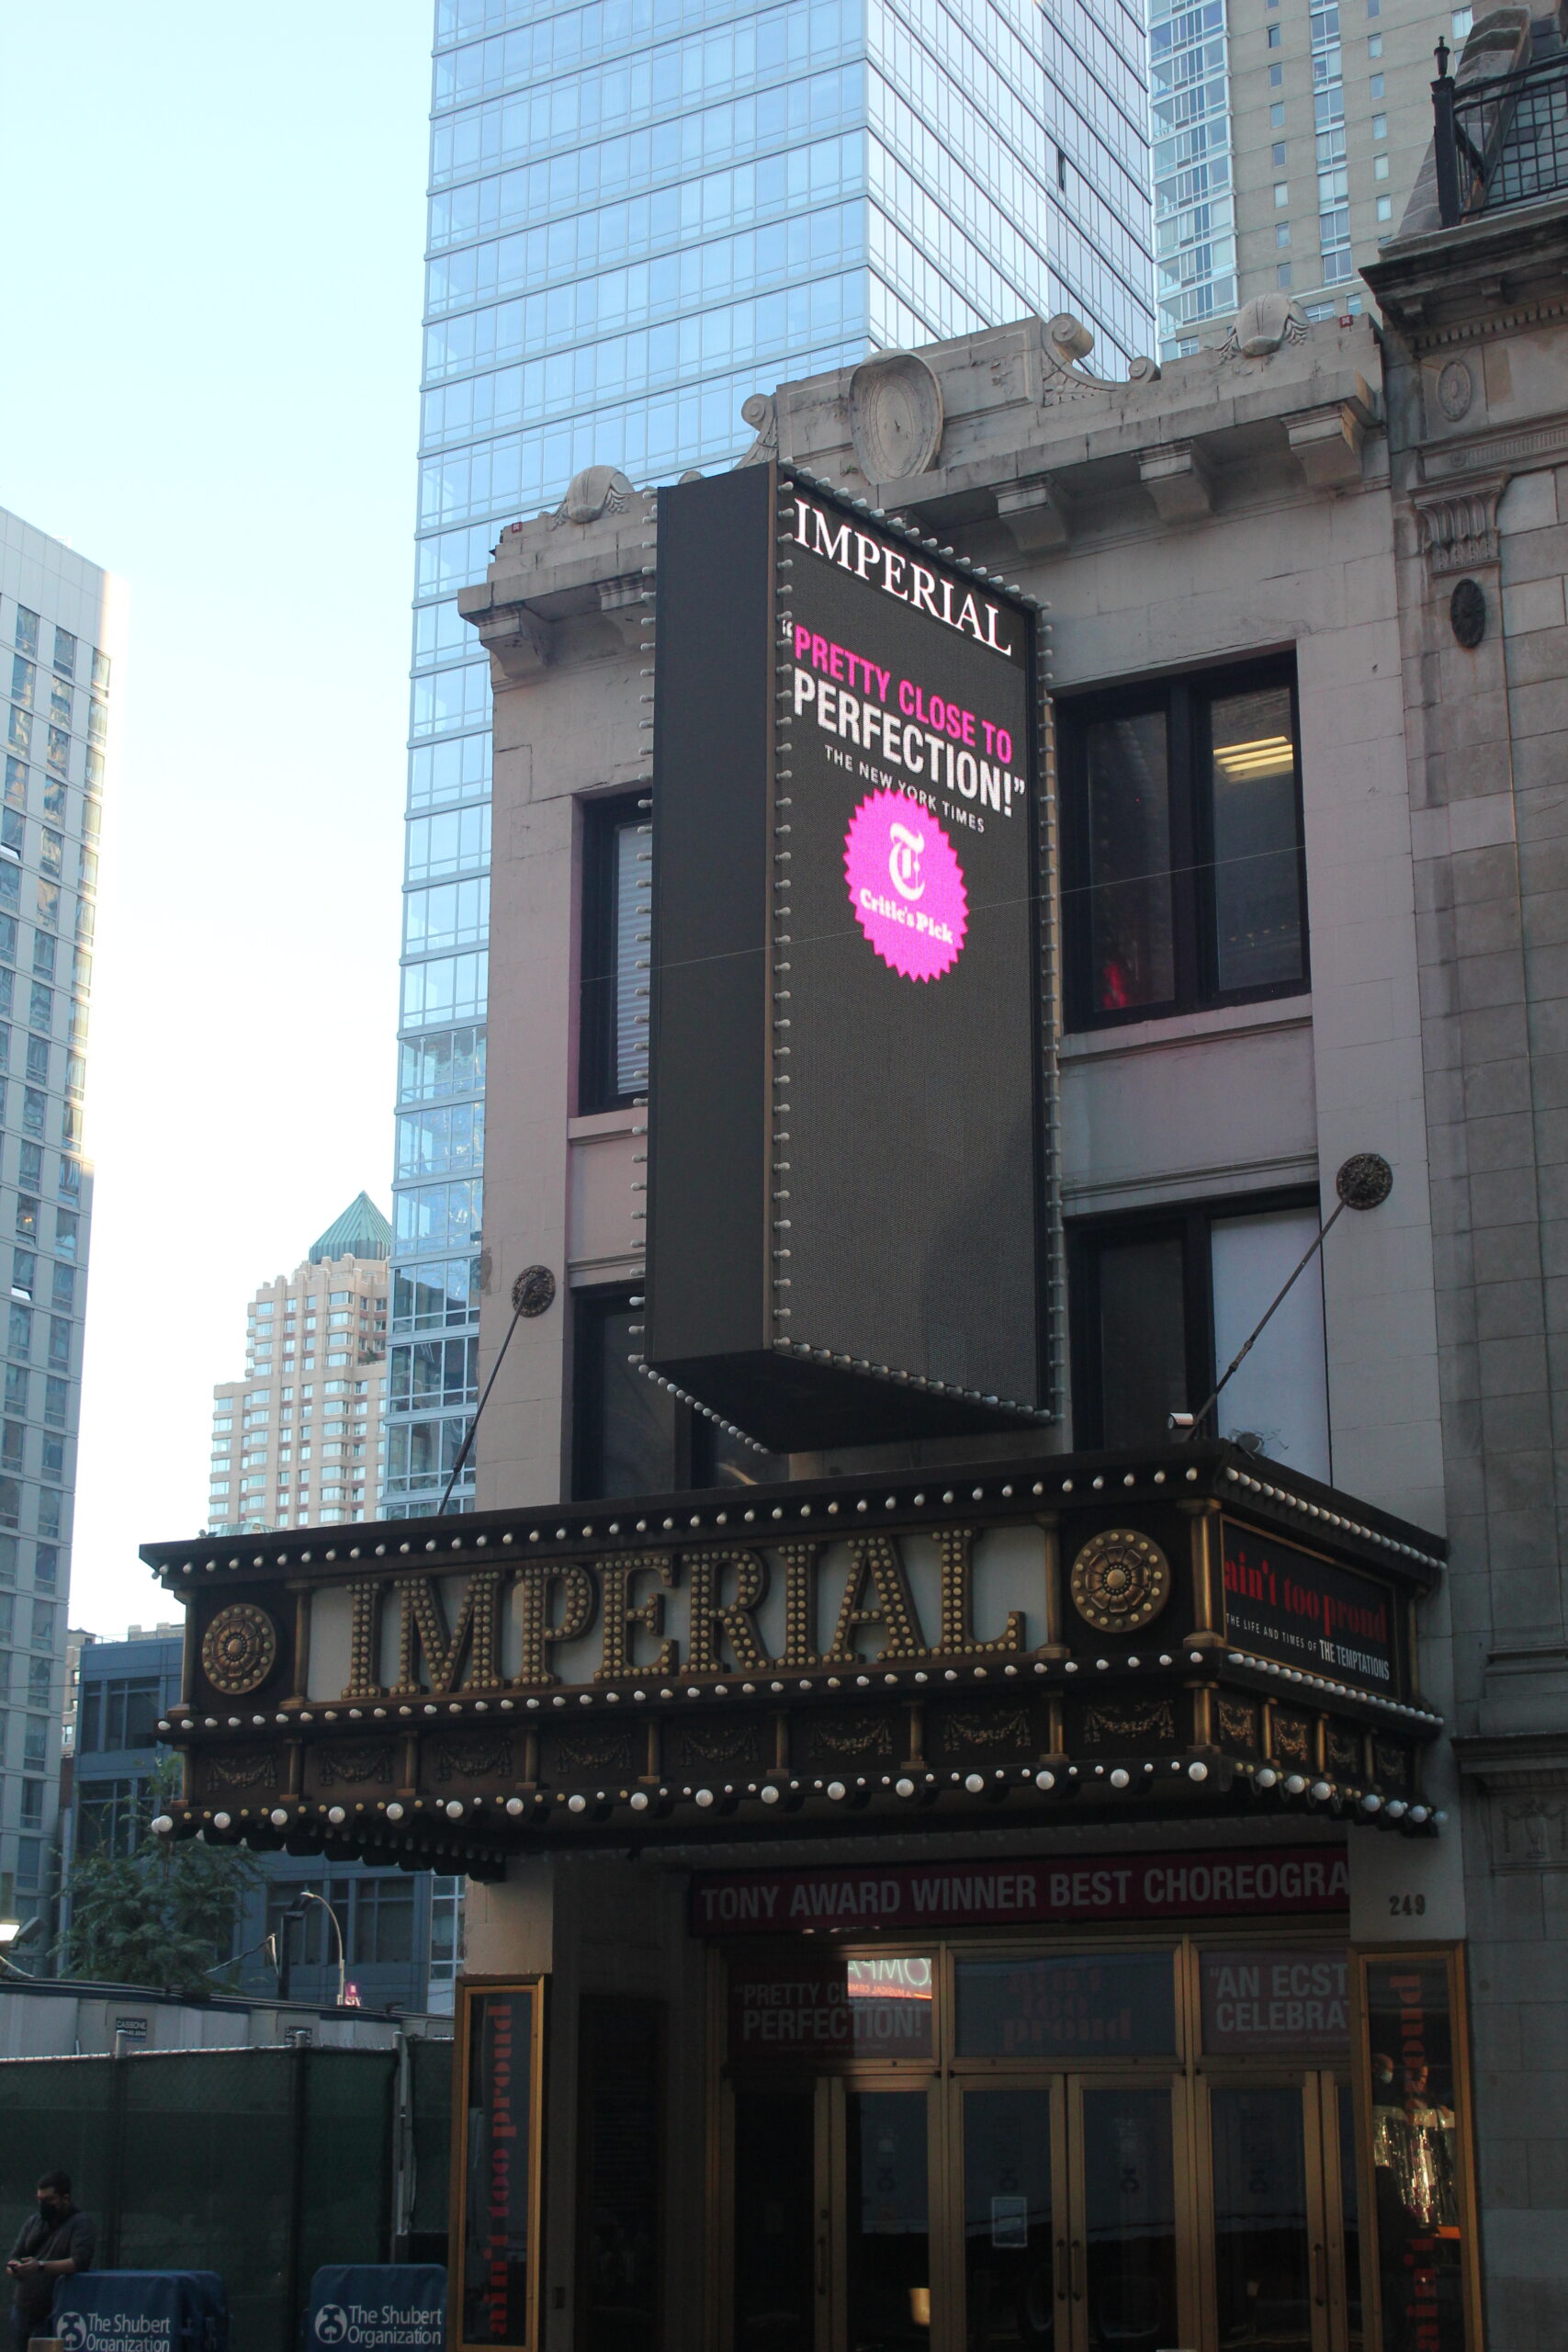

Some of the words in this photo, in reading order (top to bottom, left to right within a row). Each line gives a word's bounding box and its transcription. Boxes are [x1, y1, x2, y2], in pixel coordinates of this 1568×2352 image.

[794, 497, 1012, 656] IMPERIAL
[899, 679, 976, 747] CLOSE
[983, 718, 1013, 764] TO
[824, 744, 853, 772] THE
[859, 761, 893, 789] NEW
[897, 779, 937, 812] YORK
[942, 800, 986, 833] TIMES
[860, 888, 914, 928] Critic's
[916, 910, 953, 944] Pick
[341, 1527, 1026, 1700] IMPERIAL
[1224, 1551, 1277, 1606] ain't
[1283, 1574, 1320, 1622] too
[1323, 1594, 1389, 1645] proud
[1226, 1612, 1240, 1627] THE
[1244, 1620, 1260, 1634] LIFE
[1263, 1626, 1279, 1640] AND
[1282, 1632, 1304, 1648] TIMES
[1308, 1640, 1317, 1652] OF
[1319, 1639, 1336, 1663] THE
[1336, 1645, 1390, 1680] TEMPTATIONS
[700, 1885, 779, 1920] TONY
[790, 1880, 901, 1917] AWARD
[911, 1874, 1036, 1912] WINNER
[1050, 1871, 1133, 1906] BEST
[1144, 1860, 1350, 1904] CHOREOGRA
[1389, 1894, 1426, 1916] 249
[1003, 2007, 1133, 2052] proud
[487, 2004, 517, 2139] proud
[86, 2333, 170, 2352] Organization
[87, 2312, 110, 2332] The
[113, 2312, 171, 2334] Shubert
[346, 2325, 442, 2349] Organization
[348, 2304, 378, 2324] The
[381, 2304, 442, 2325] Shubert
